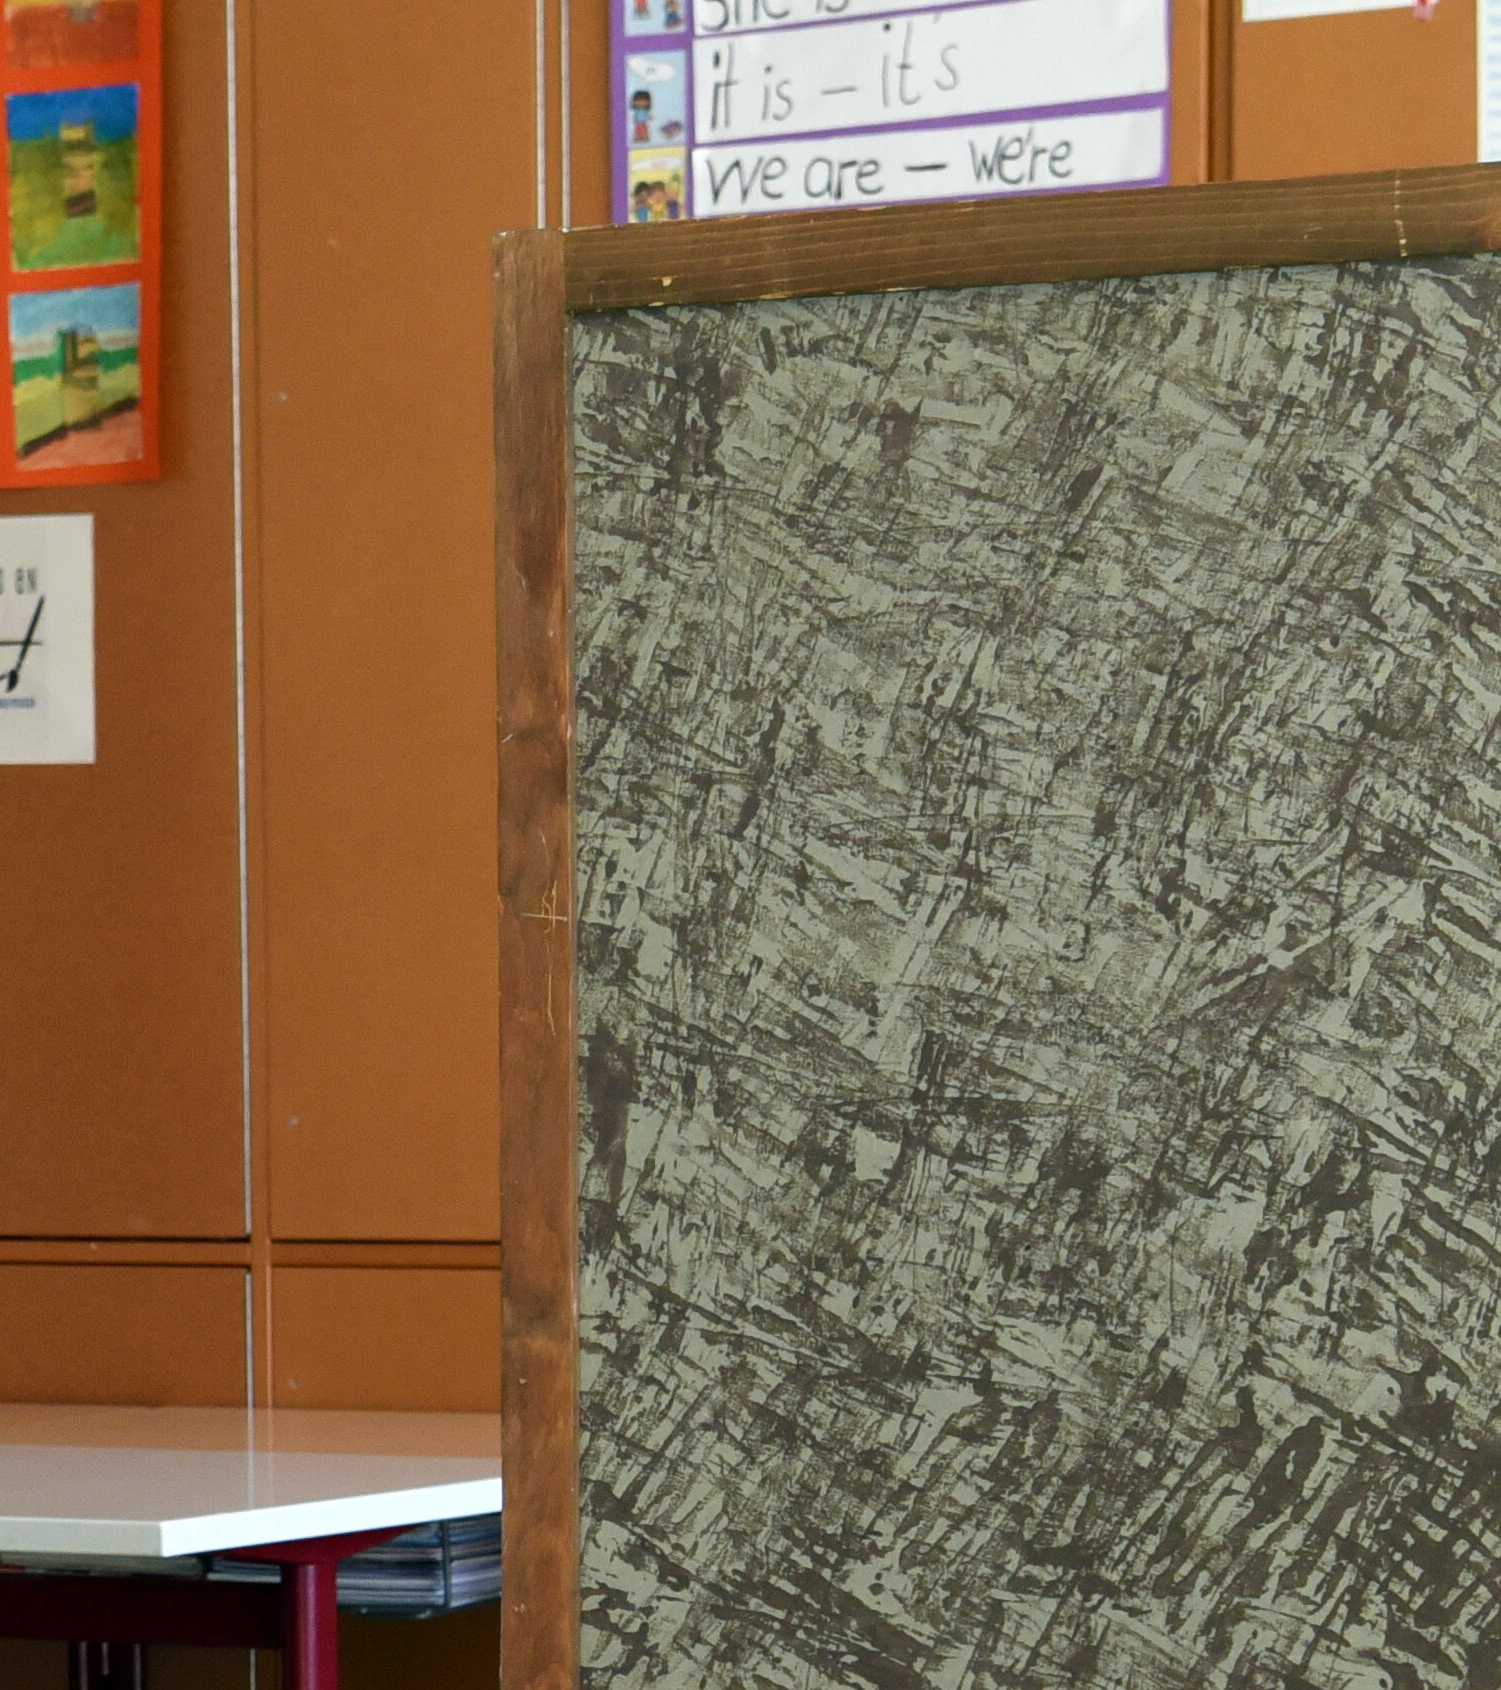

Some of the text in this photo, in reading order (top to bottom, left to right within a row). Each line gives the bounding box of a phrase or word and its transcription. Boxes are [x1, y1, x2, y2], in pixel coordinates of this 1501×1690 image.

[710, 42, 738, 130] it
[761, 64, 793, 121] is
[881, 12, 961, 107] it's
[803, 156, 884, 199] are
